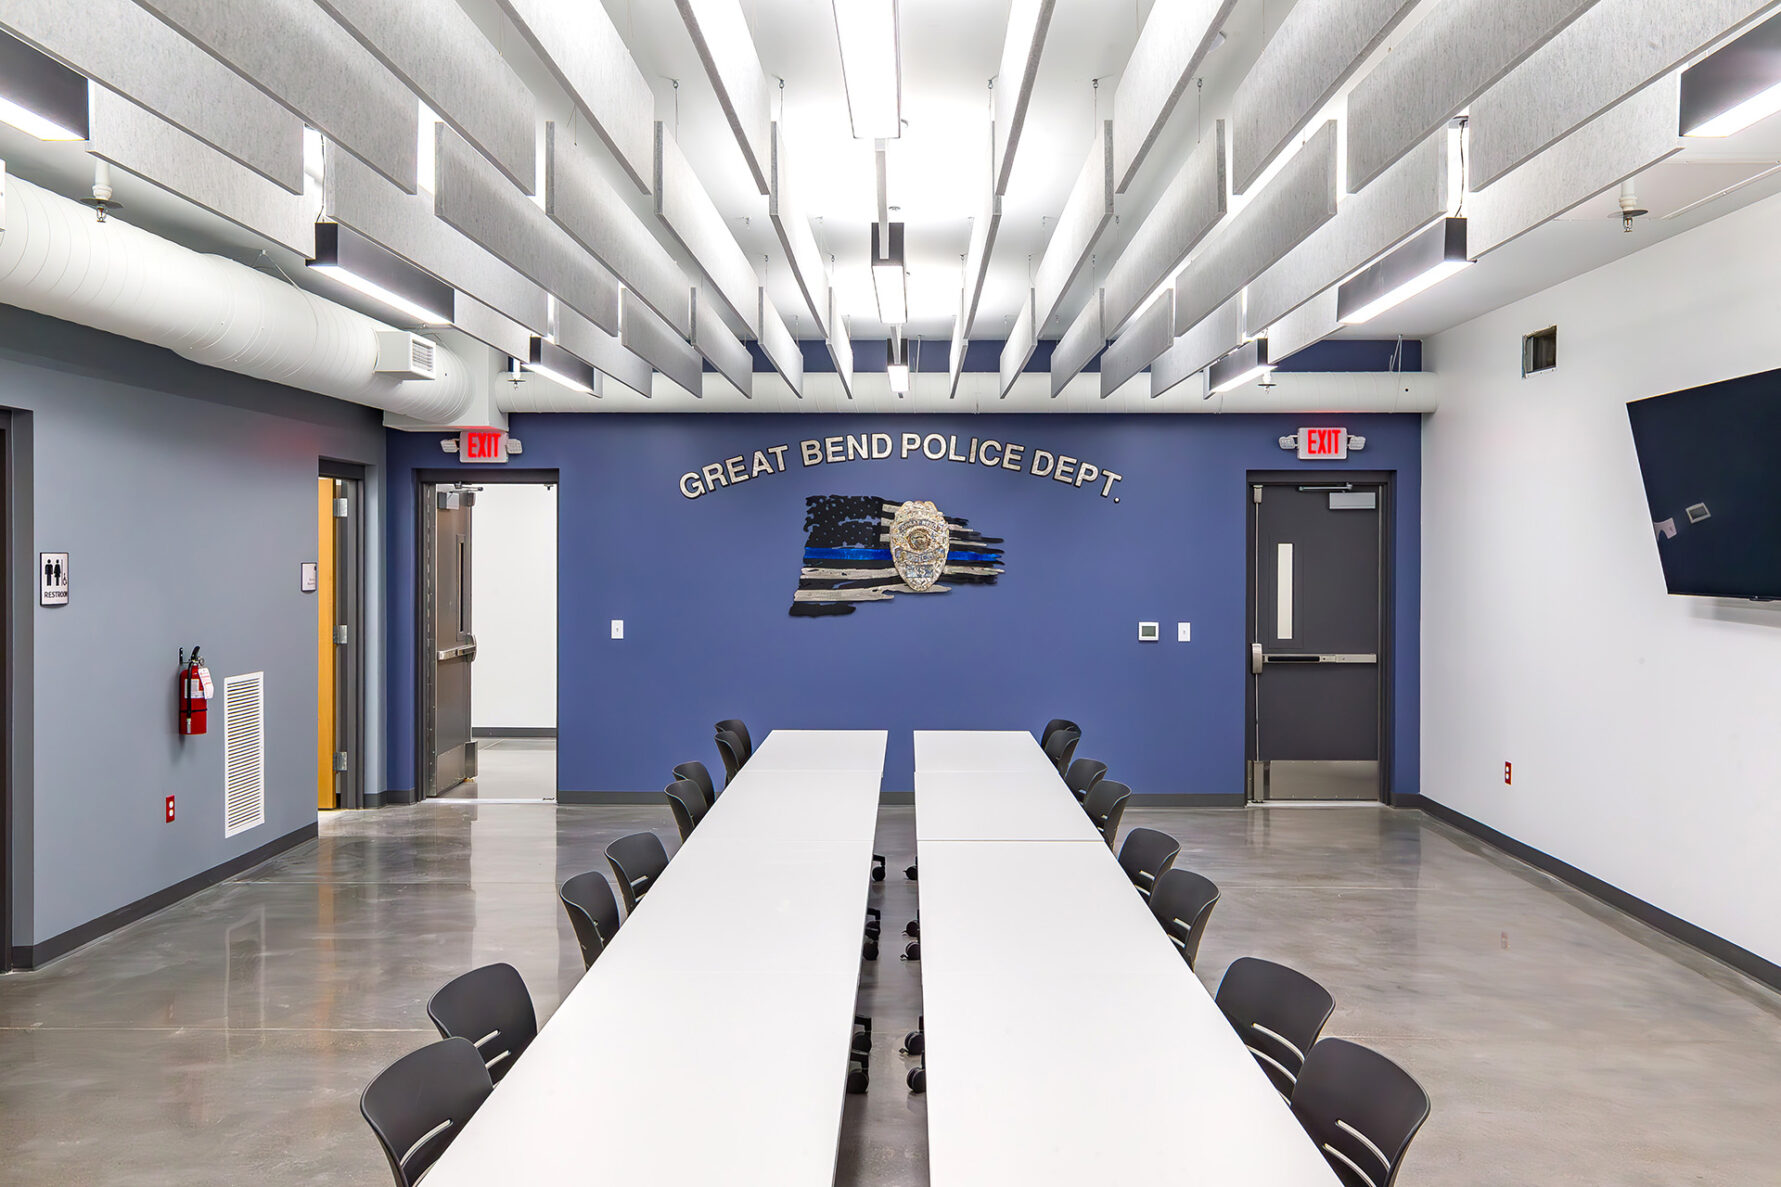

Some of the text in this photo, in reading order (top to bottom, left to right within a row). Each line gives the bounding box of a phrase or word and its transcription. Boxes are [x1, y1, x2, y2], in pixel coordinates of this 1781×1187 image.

[467, 432, 501, 458] EXIT
[1307, 429, 1341, 454] EXIT
[679, 432, 1123, 503] GREAT BEND POLICE DEPT.
